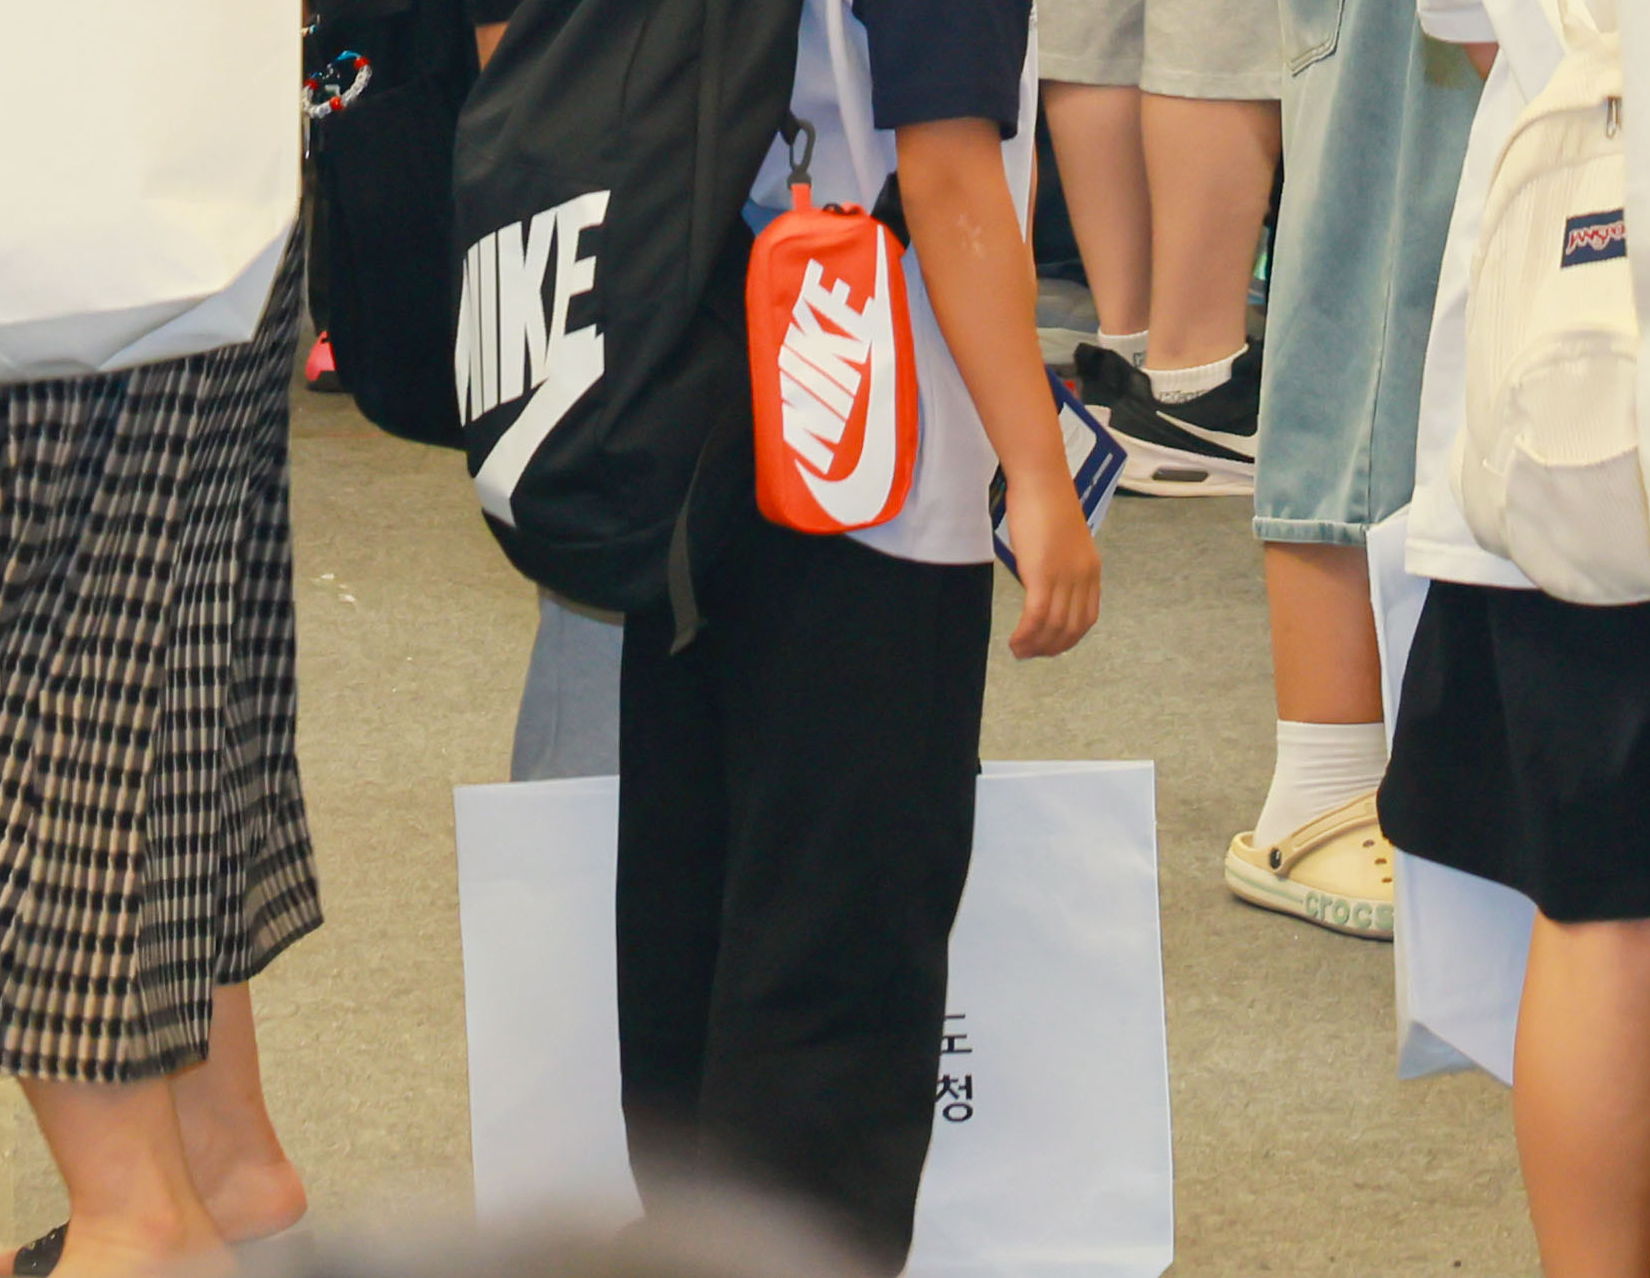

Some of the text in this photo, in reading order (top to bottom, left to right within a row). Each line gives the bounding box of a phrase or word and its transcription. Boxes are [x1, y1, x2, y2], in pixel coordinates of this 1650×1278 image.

[454, 189, 611, 427] NIKE
[779, 258, 876, 475] NIKE
[1305, 891, 1394, 930] crocs
